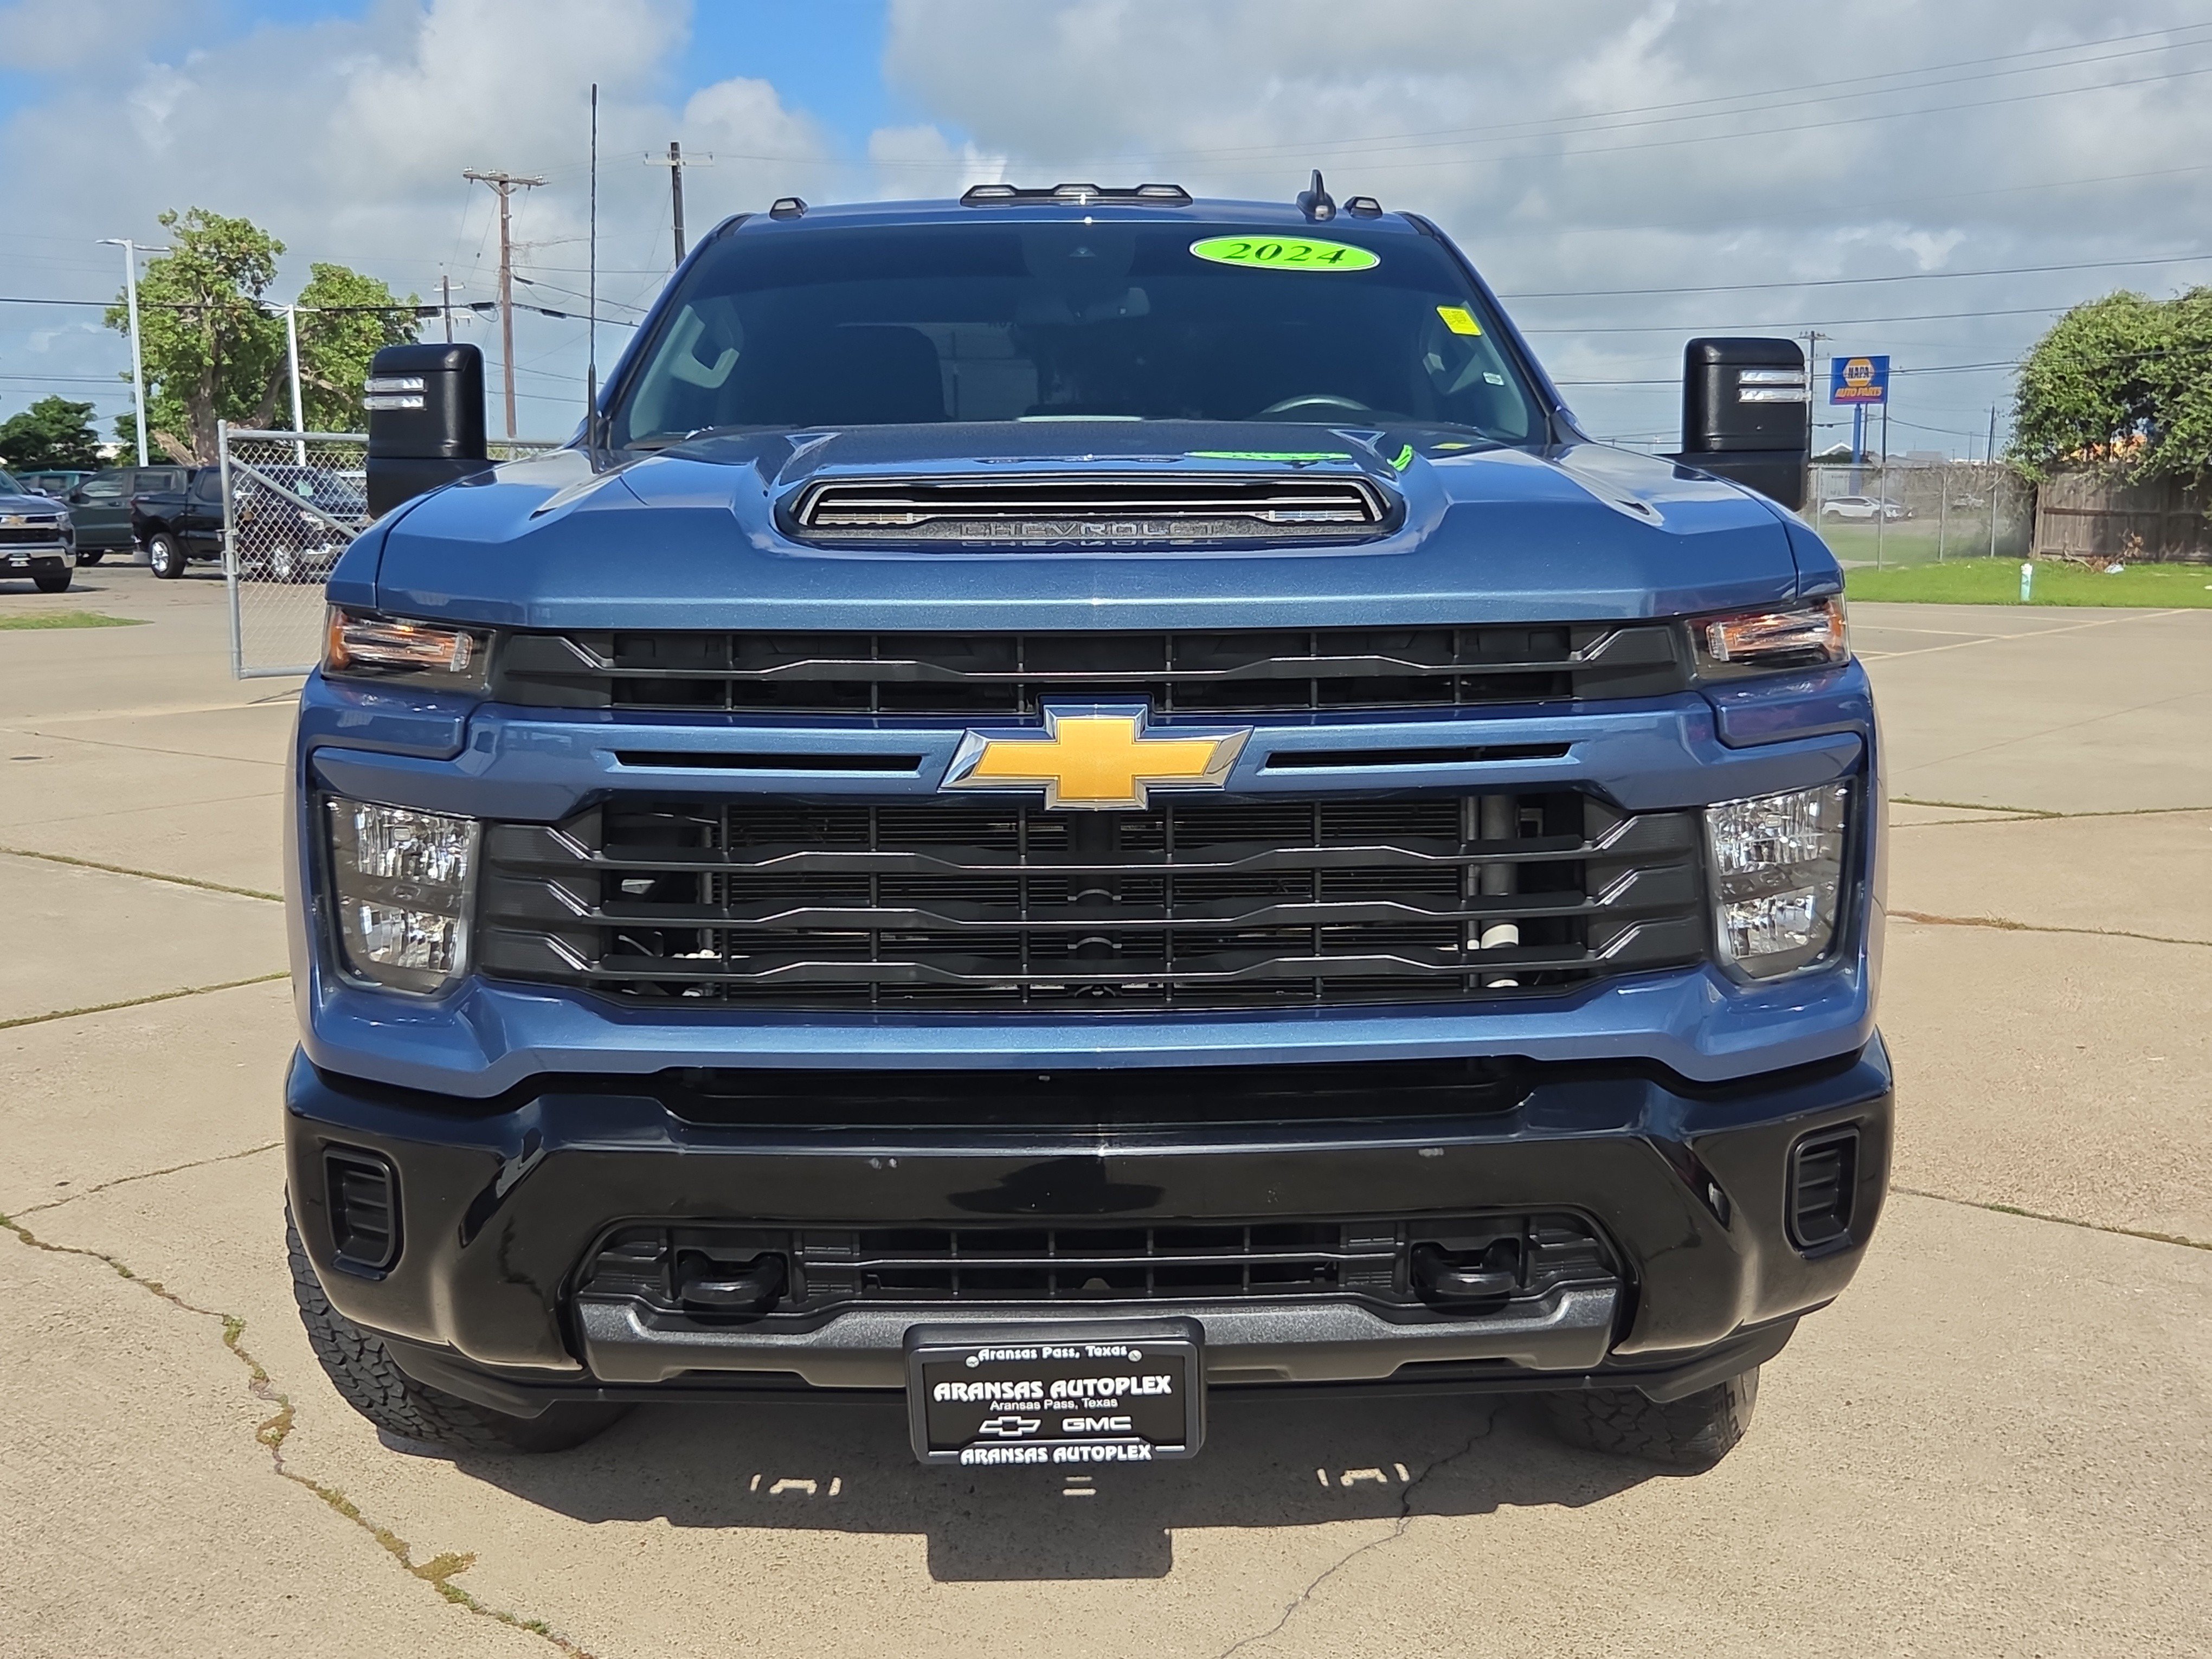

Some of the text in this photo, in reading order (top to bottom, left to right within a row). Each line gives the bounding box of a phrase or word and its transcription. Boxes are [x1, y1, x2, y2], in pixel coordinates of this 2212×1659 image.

[1222, 243, 1347, 264] 2024
[1835, 387, 1882, 397] AUTO PARTS
[961, 522, 1220, 537] CHEVROLET
[978, 1345, 1128, 1362] Aransas Pass, Texas
[933, 1375, 1172, 1402] ARANSAS AUTOPLEX
[989, 1398, 1118, 1411] Aransas Pass, Texas
[1062, 1416, 1132, 1432] GMC
[960, 1443, 1152, 1465] ARANSAS AUTOPLEX
